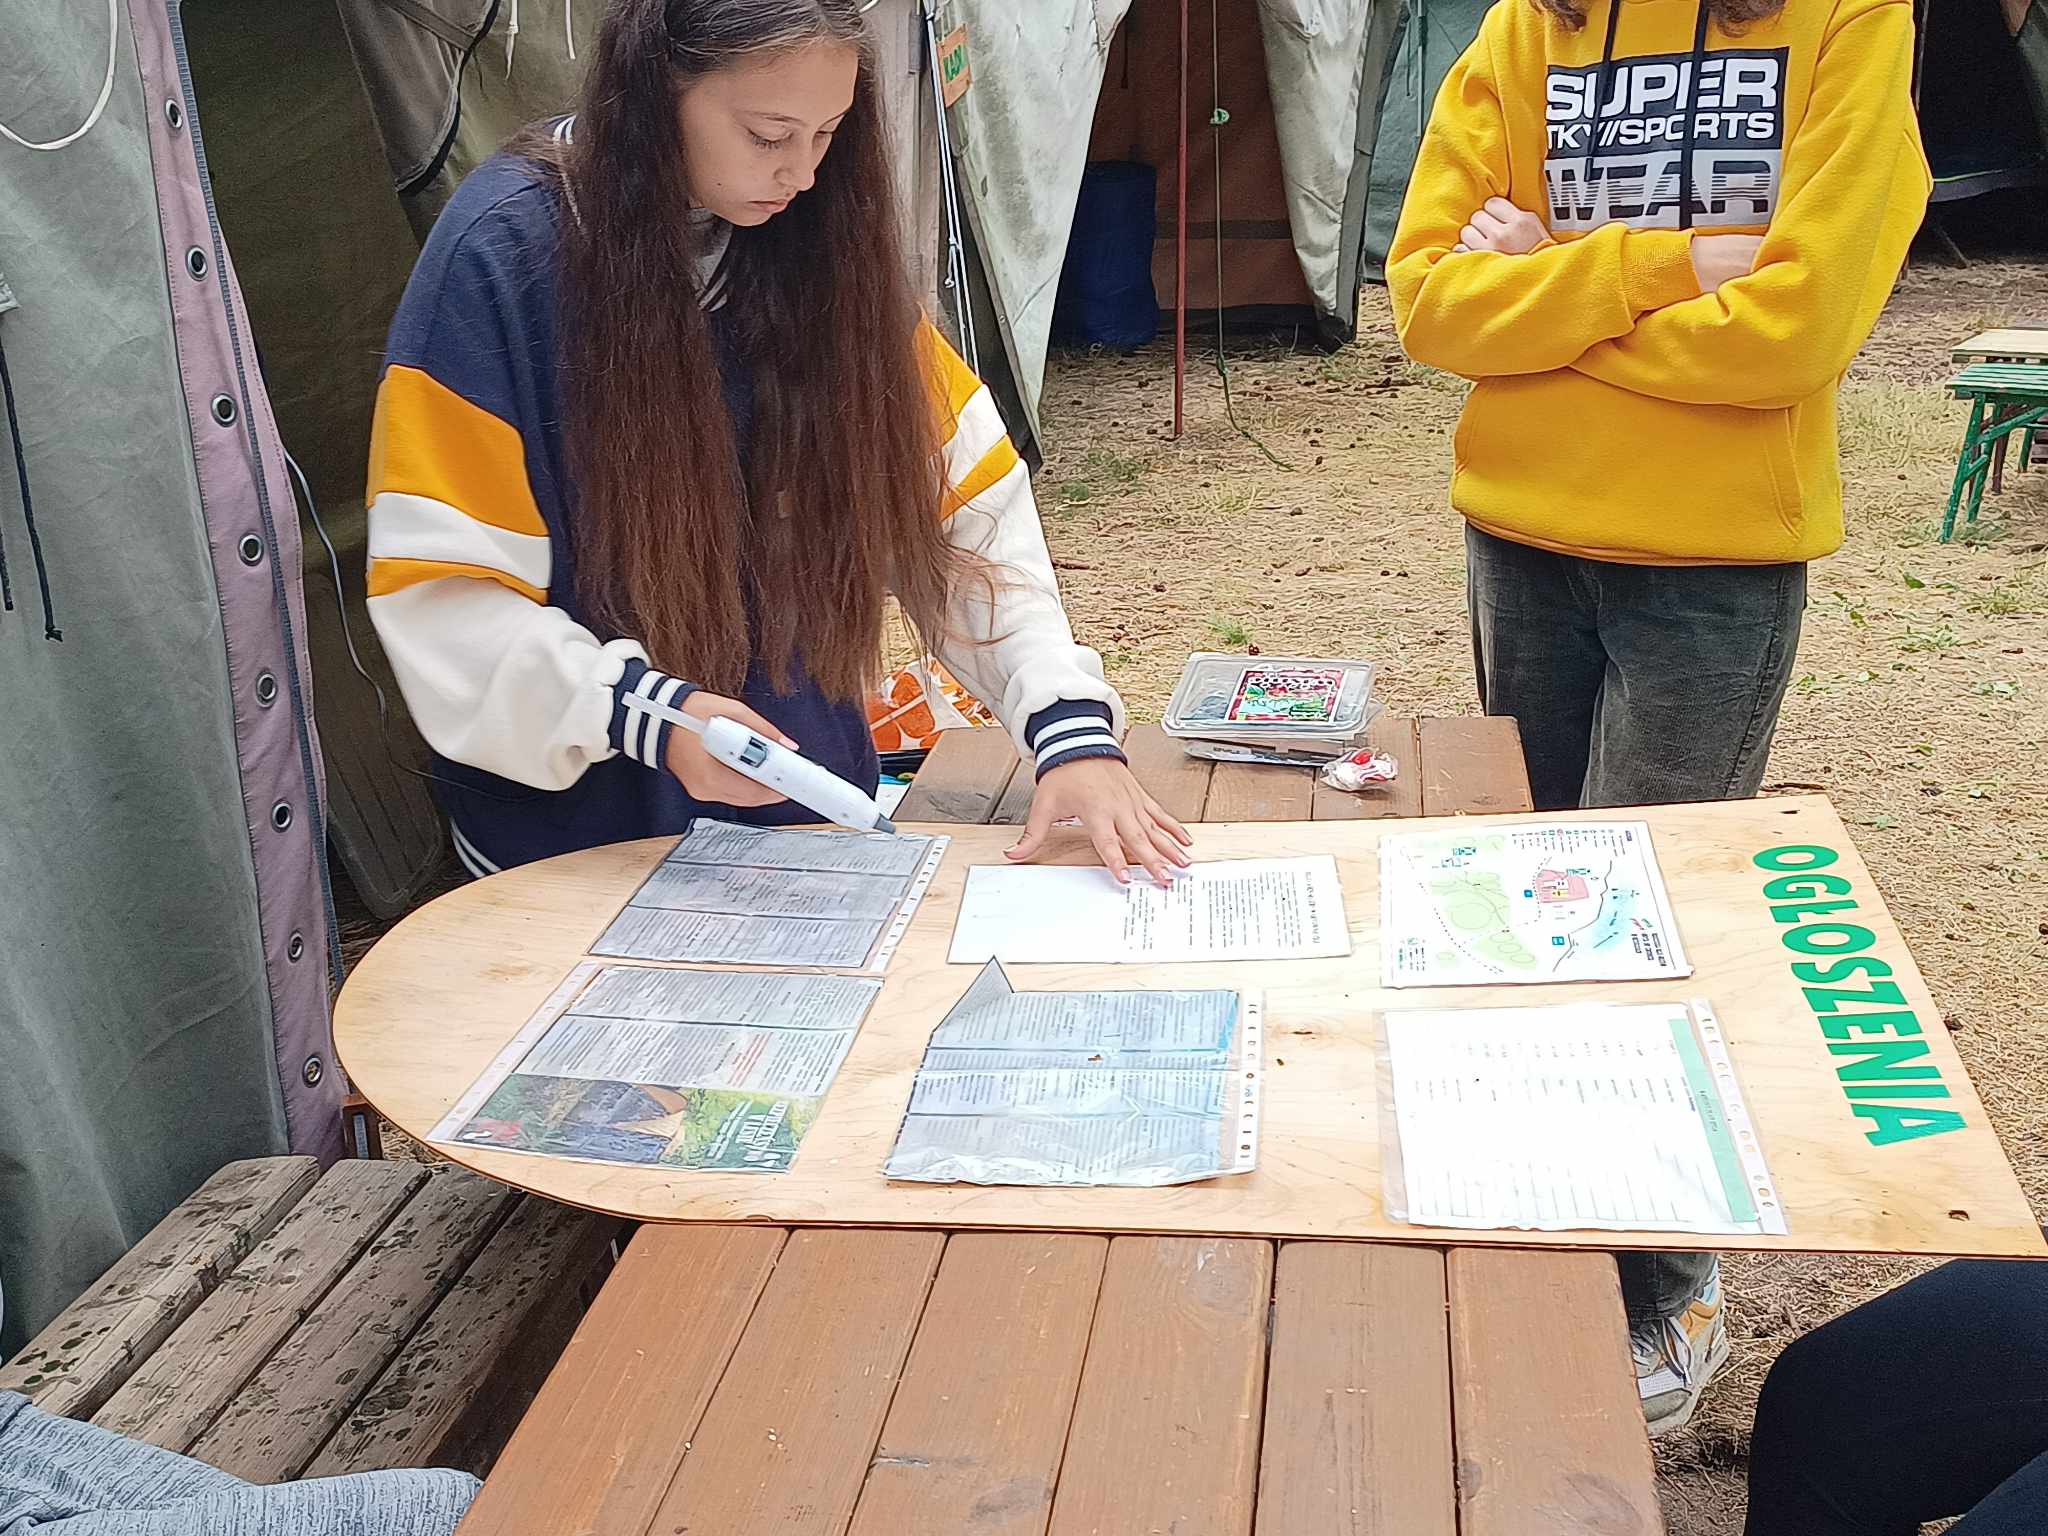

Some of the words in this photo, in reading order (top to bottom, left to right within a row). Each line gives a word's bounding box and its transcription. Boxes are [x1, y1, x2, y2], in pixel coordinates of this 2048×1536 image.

[1546, 58, 1778, 121] SUPER
[1546, 160, 1771, 220] WEAR
[1753, 845, 1968, 1146] OGŁOSZENIA
